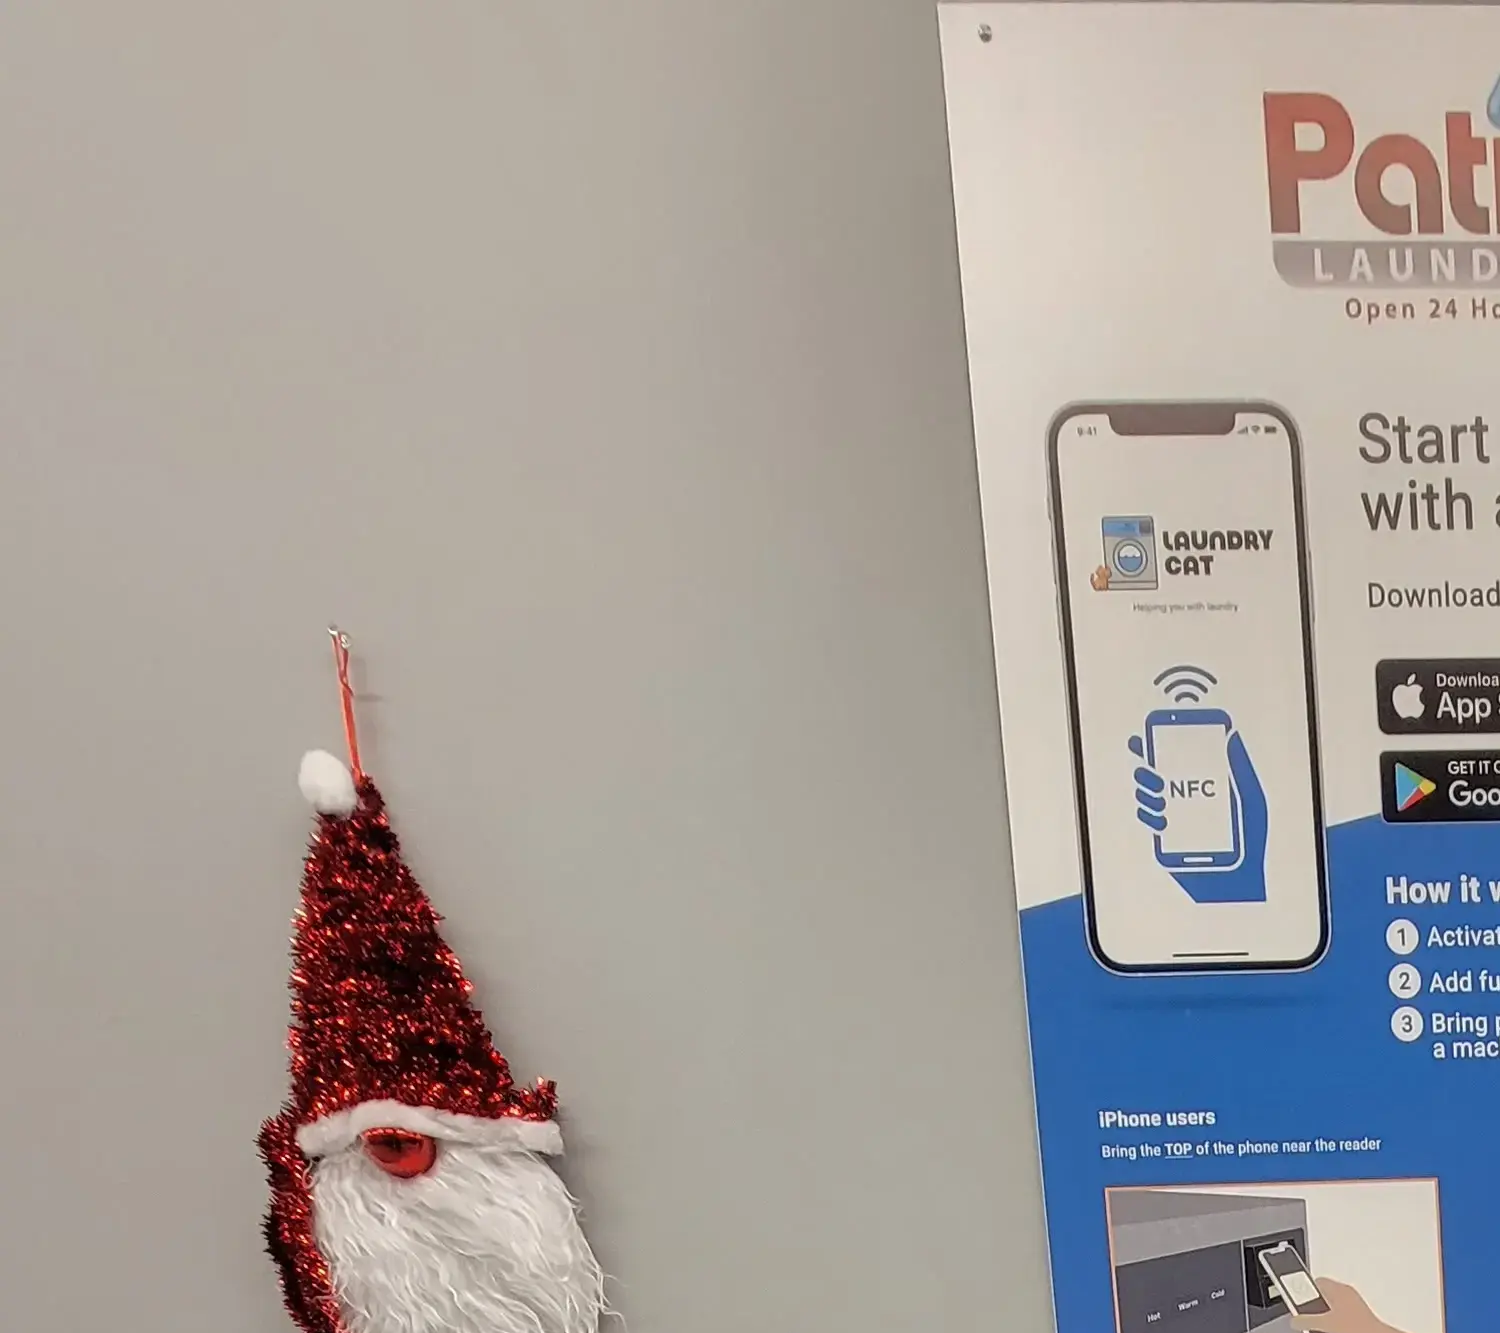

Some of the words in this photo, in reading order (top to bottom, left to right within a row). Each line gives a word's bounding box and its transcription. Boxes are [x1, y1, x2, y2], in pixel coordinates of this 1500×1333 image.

[1345, 297, 1416, 322] Open
[1427, 297, 1459, 321] 24
[1358, 411, 1490, 465] Start
[1360, 477, 1474, 531] with
[1162, 529, 1274, 551] LAUNDRY
[1164, 555, 1215, 576] CAT
[1367, 581, 1500, 609] Download
[1436, 693, 1492, 724] App
[1447, 760, 1476, 776] GET
[1478, 760, 1492, 775] IT
[1169, 778, 1217, 800] NFC
[1385, 875, 1451, 905] How
[1460, 873, 1481, 903] it
[1429, 971, 1473, 993] Add
[1431, 1012, 1489, 1037] Bring
[1432, 1042, 1446, 1060] a
[1098, 1110, 1162, 1129] iPhone
[1166, 1111, 1217, 1127] users
[1101, 1143, 1137, 1161] Bring
[1140, 1142, 1161, 1157] the
[1164, 1142, 1193, 1158] TOP
[1196, 1141, 1211, 1155] of
[1212, 1141, 1234, 1155] the
[1238, 1139, 1279, 1157] phone
[1282, 1140, 1312, 1154] near
[1314, 1138, 1336, 1152] the
[1339, 1136, 1382, 1151] reader
